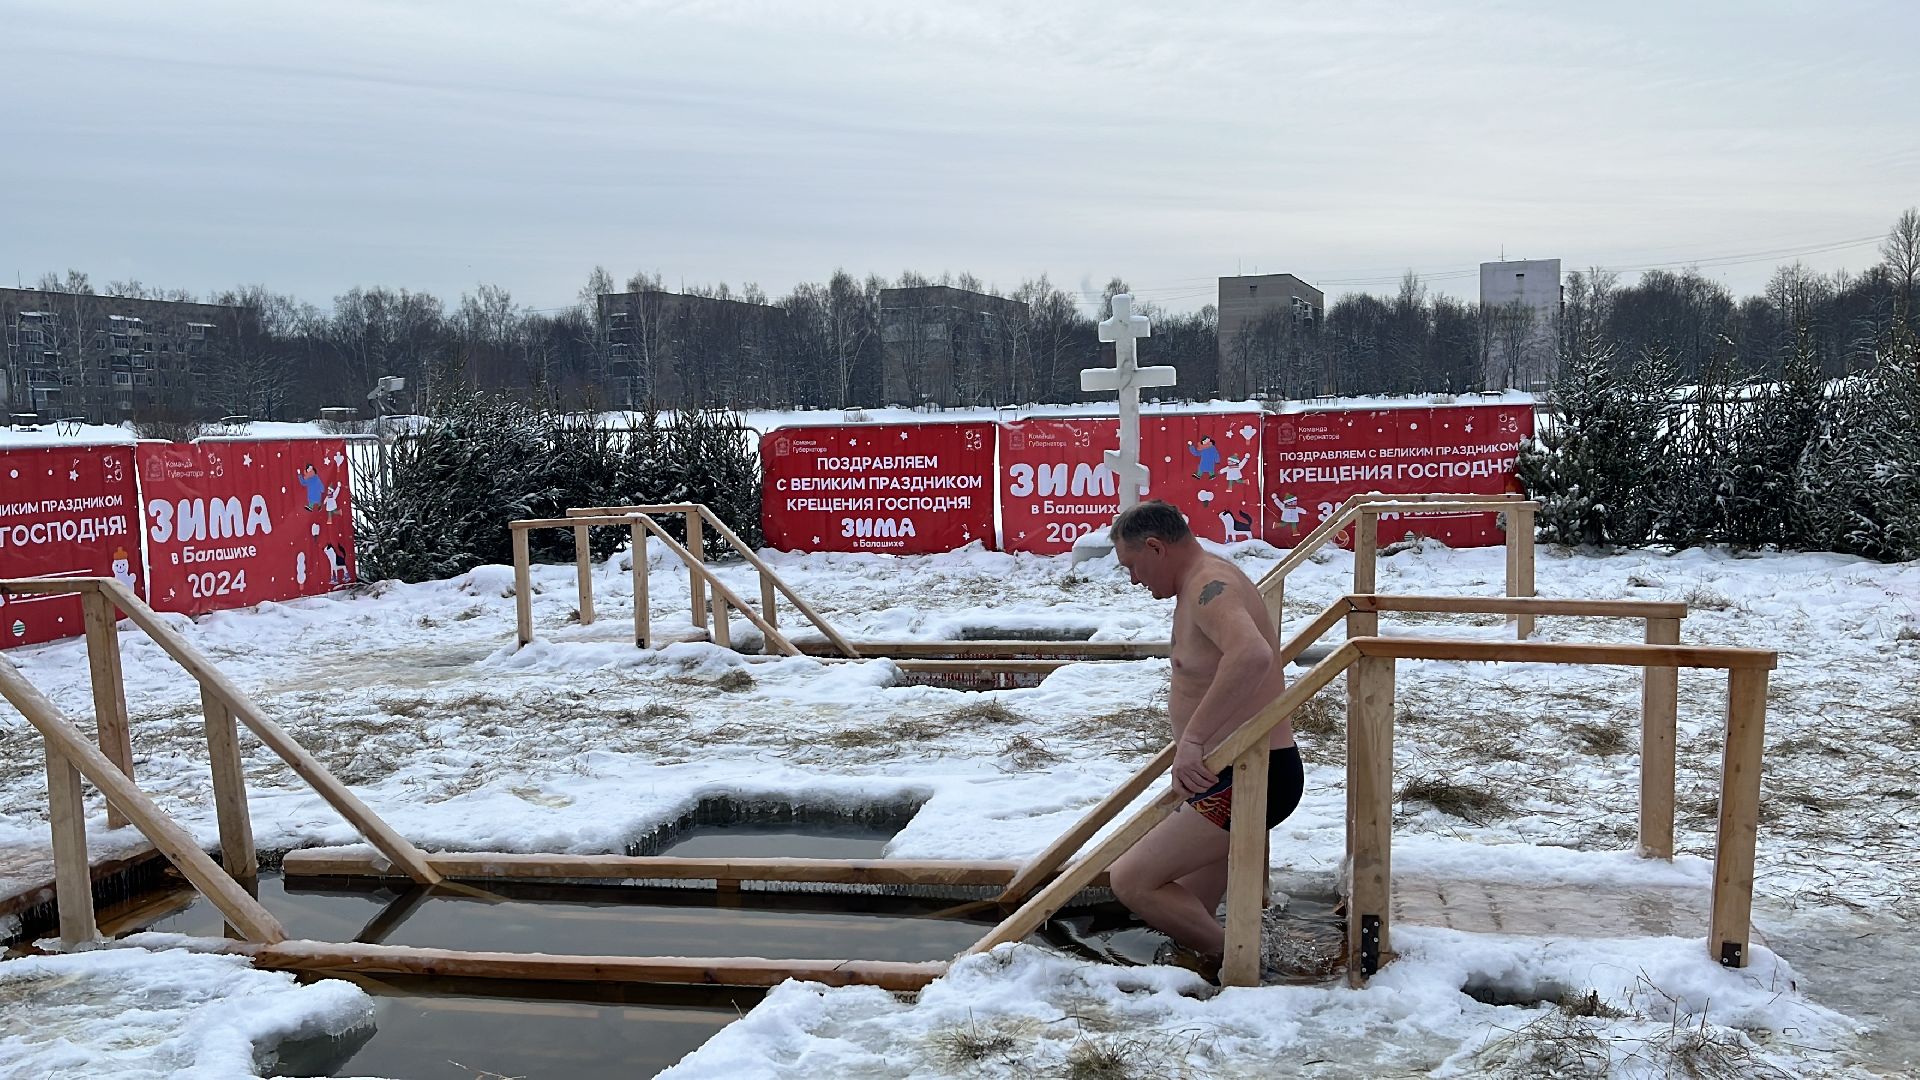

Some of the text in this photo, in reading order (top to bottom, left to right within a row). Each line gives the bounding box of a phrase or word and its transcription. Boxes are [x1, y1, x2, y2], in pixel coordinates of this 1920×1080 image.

[1280, 442, 1519, 463] ПОЗДРАВЛЯЕМ С ВЕЛИКИМ ПРАЗДНИКОМ
[817, 455, 938, 472] ПОЗДРАВЛЯЕМ
[1279, 463, 1393, 484] КРЕЩЕНИЯ
[776, 475, 982, 492] С ВЕЛИКИМ ПРАЗДНИКОМ
[1009, 462, 1150, 497] ЗИМ
[0, 494, 123, 517] ИКИМ ПРАЗДНИКОМ
[786, 495, 971, 513] КРЕЩЕНИЯ ГОСПОДНЯ!
[1031, 504, 1039, 514] в
[148, 494, 273, 543] ЗИМА
[841, 517, 916, 538] ЗИМА
[1046, 522, 1107, 543] 202
[860, 539, 905, 548] Балашихе
[170, 545, 257, 565] в Балашихе
[187, 569, 247, 598] 2024
